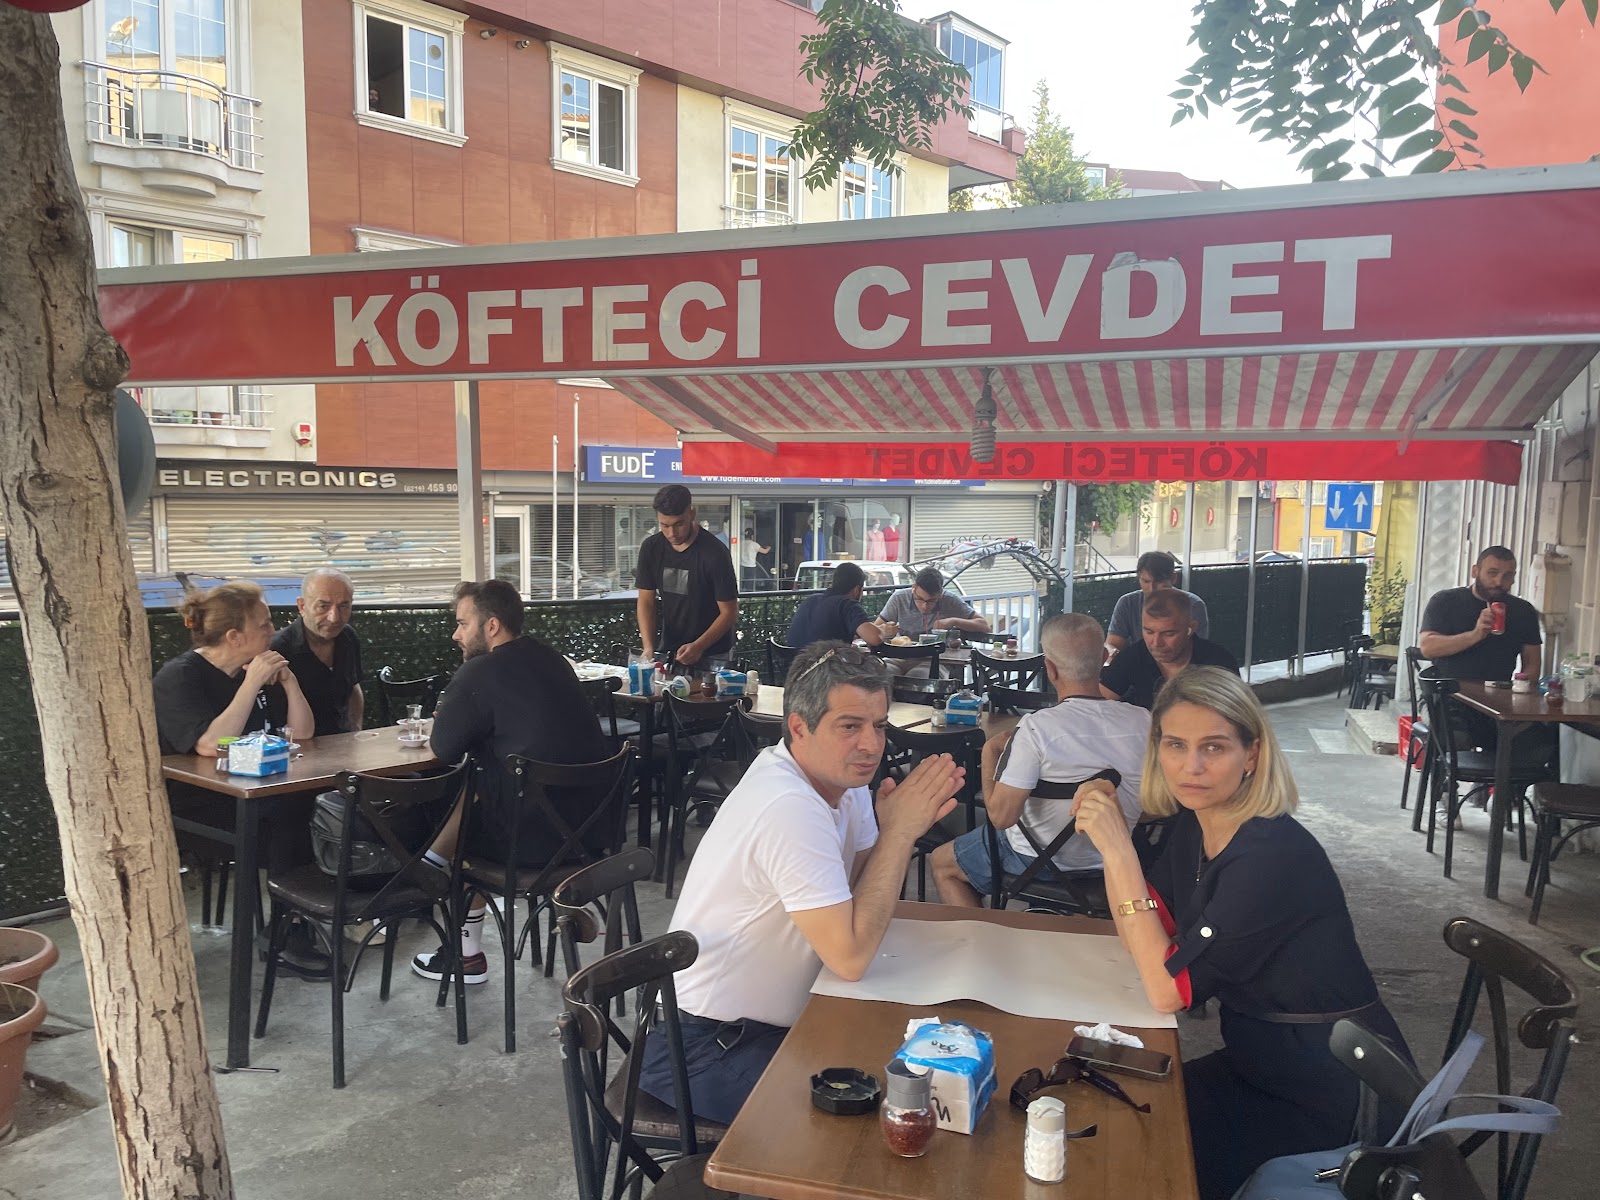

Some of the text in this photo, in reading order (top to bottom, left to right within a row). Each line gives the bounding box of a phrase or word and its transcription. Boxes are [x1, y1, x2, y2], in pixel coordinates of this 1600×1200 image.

[333, 234, 1393, 367] KÖFTECİ CEVDET
[601, 452, 656, 479] FUDE
[159, 469, 397, 488] ELECTRONICS
[446, 483, 458, 492] 90
